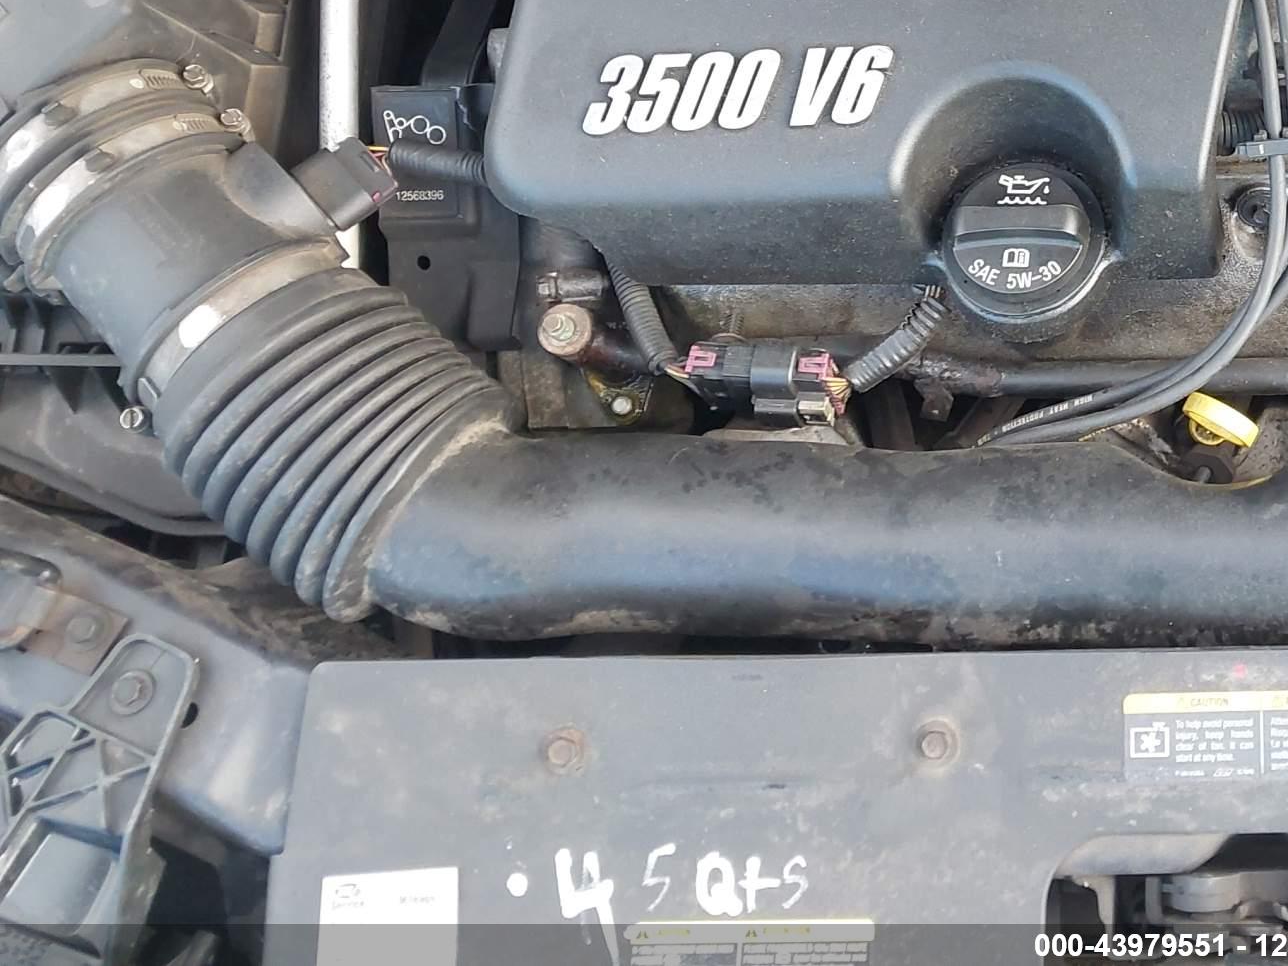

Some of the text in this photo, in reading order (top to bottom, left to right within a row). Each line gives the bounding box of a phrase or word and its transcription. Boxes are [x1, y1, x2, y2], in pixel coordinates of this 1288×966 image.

[582, 44, 895, 136] 3500 V6
[396, 190, 445, 202] 12568396
[968, 258, 1062, 290] SAE 5W-30
[1190, 697, 1230, 708] CAUTION
[1175, 720, 1185, 729] To
